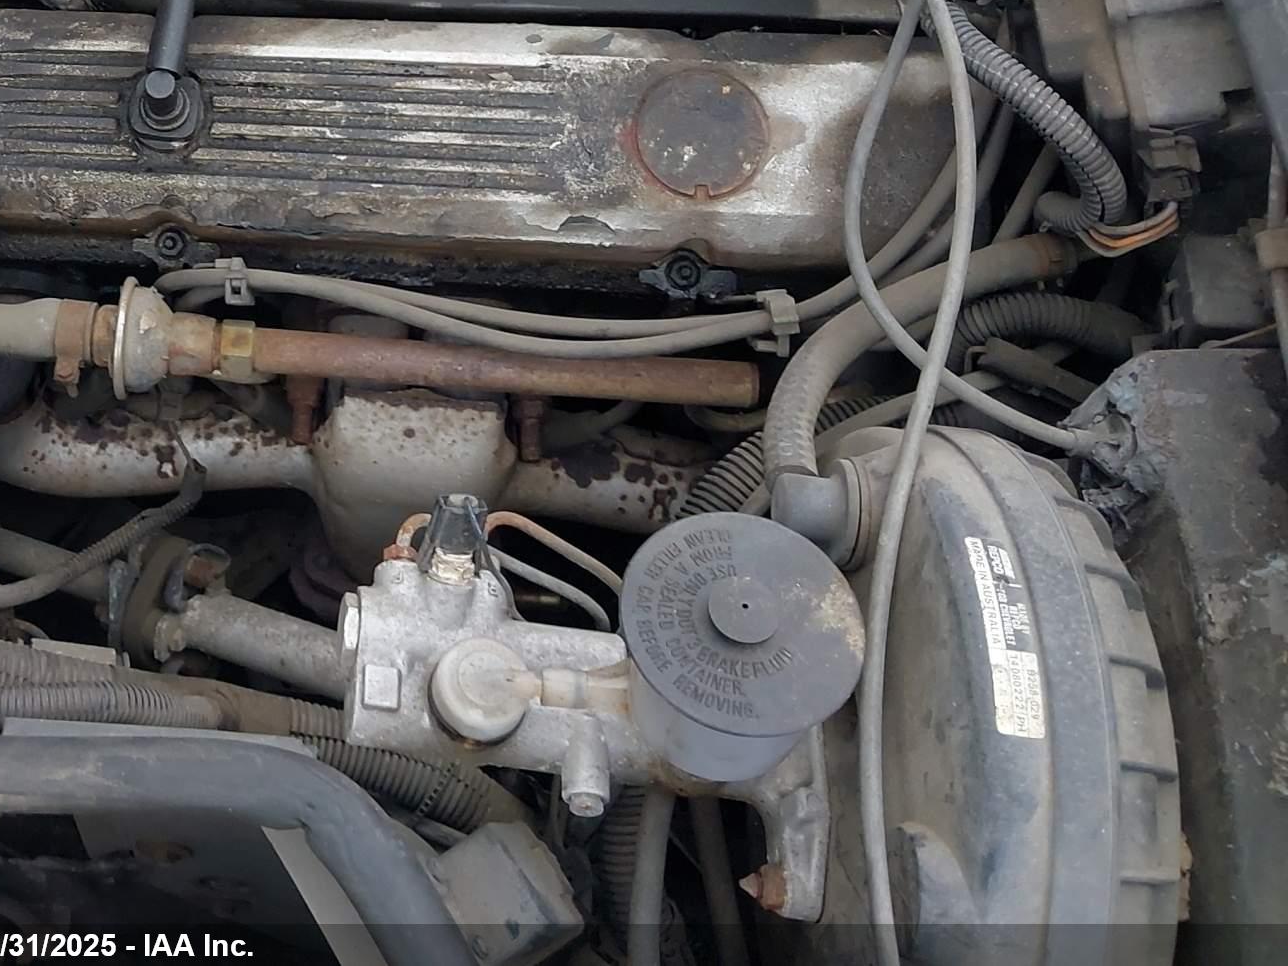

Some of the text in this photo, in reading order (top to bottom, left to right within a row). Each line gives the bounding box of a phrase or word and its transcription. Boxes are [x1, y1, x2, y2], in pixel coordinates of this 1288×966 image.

[689, 546, 733, 567] FROM
[968, 540, 985, 567] MADE
[987, 545, 1005, 575] REPCO
[673, 561, 689, 576] A
[710, 564, 737, 582] USE
[977, 570, 990, 580] IN
[656, 579, 681, 631] SEALED
[981, 583, 1003, 645] AUSTRALIA
[636, 529, 761, 720] CLEAN FILLER CAP BEFORE REMOVING.
[999, 603, 1017, 646] CHEVROLET
